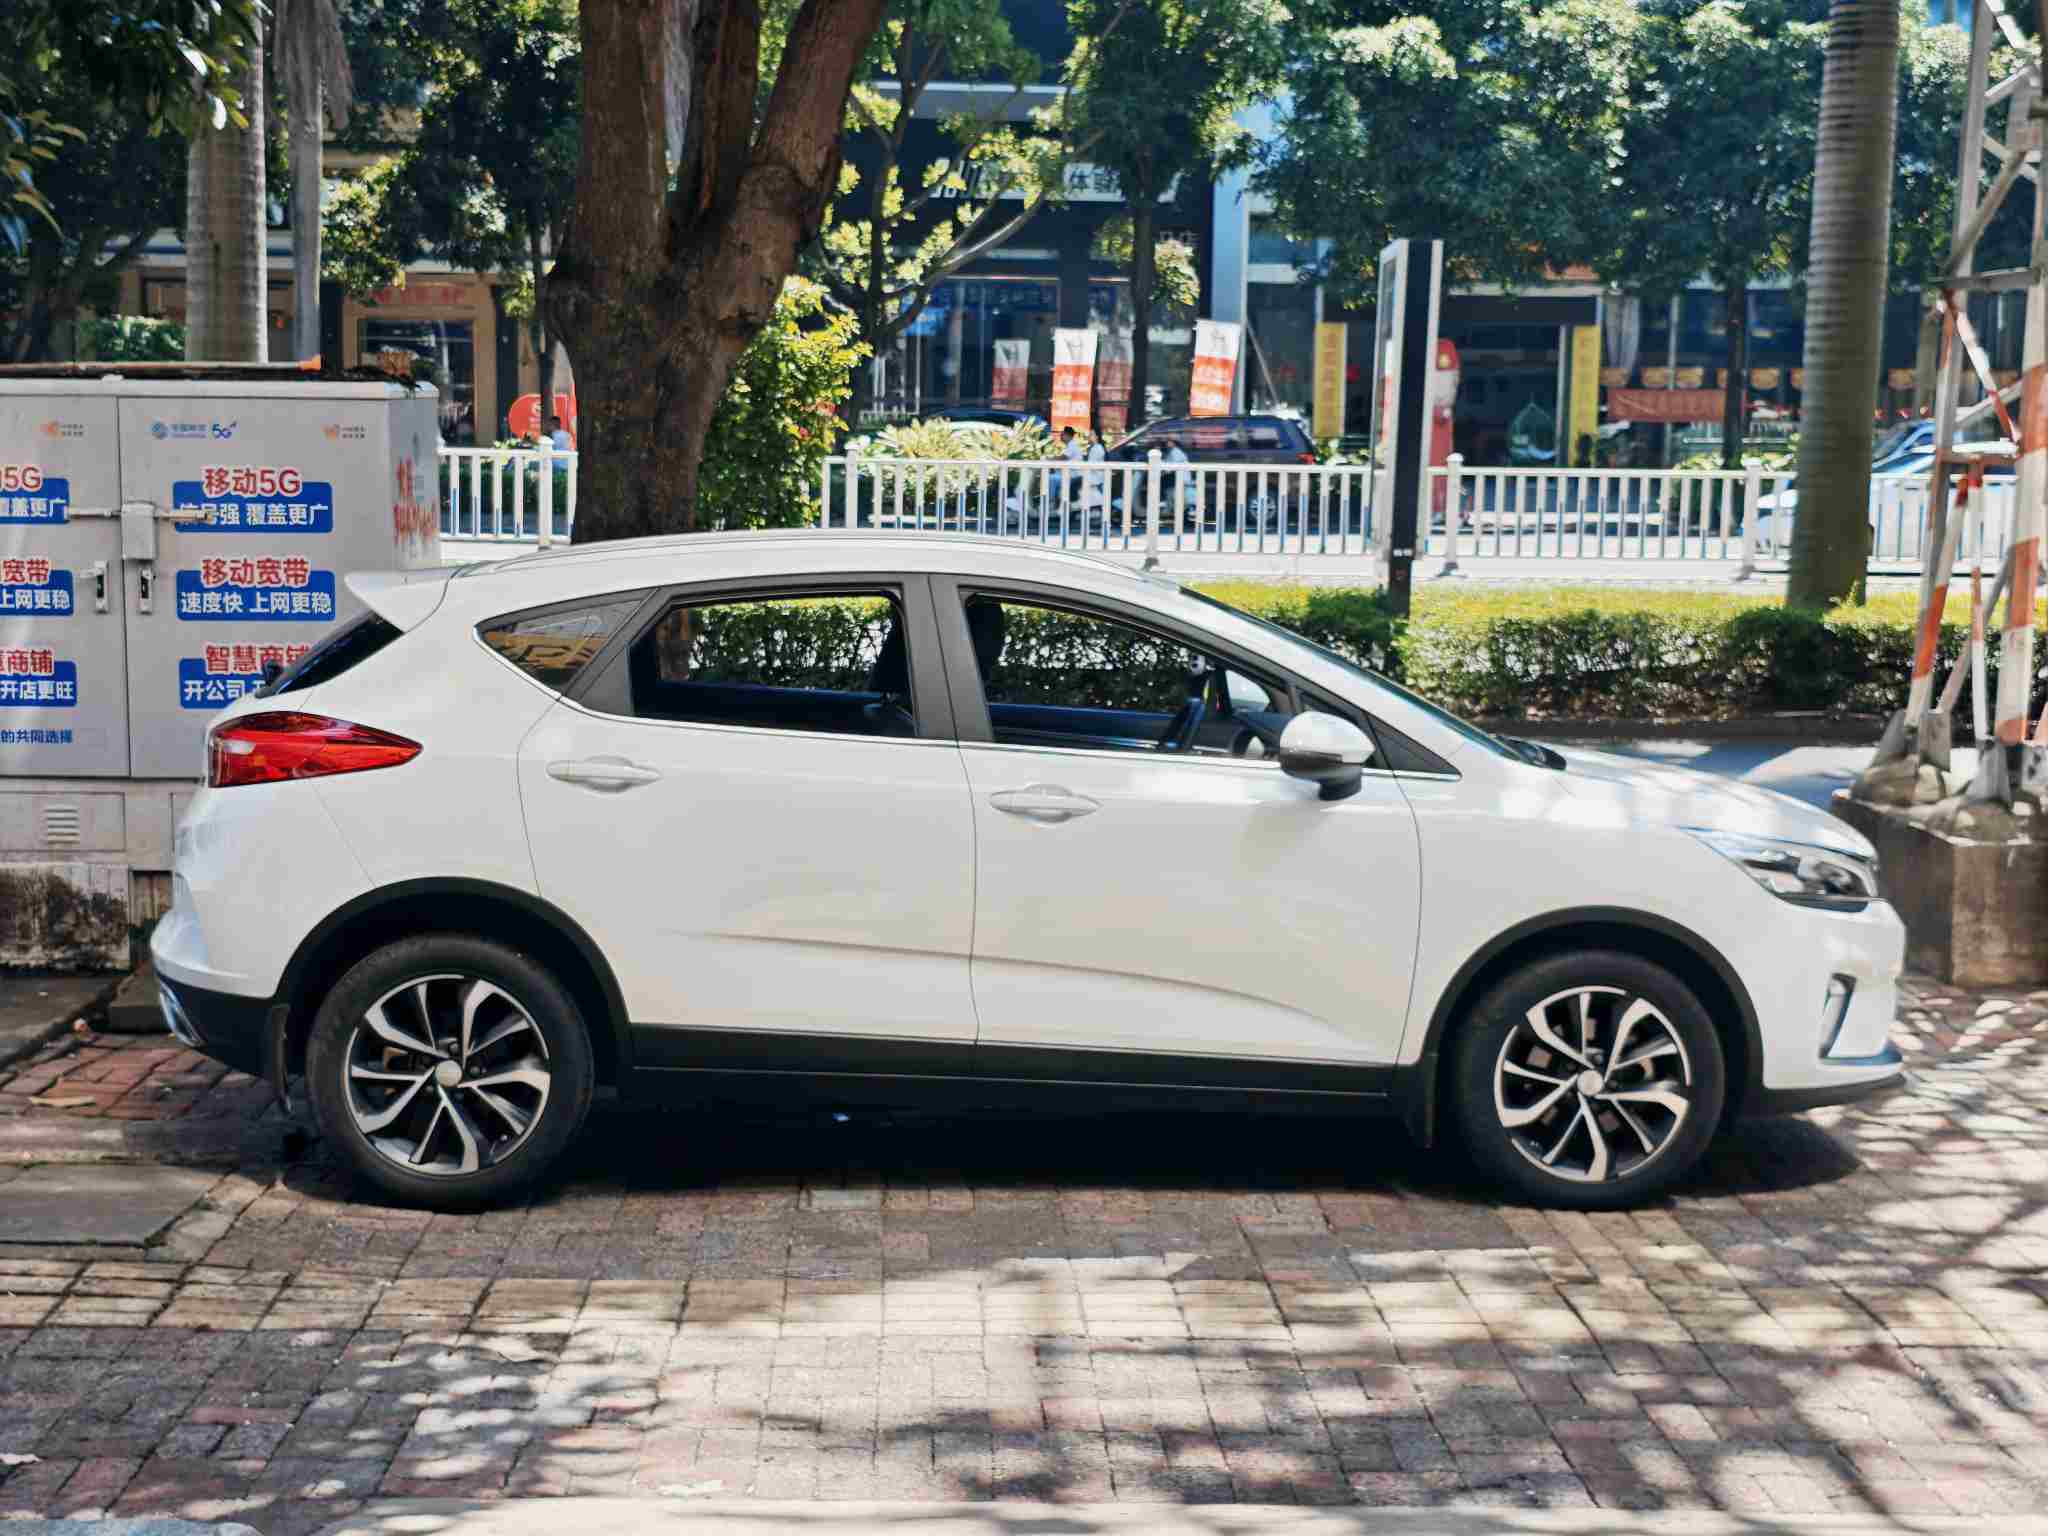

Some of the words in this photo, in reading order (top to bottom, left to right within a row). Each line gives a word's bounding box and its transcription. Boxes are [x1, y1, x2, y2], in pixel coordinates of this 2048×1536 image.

[0, 466, 42, 489] 5G
[204, 467, 301, 496] 移动5G
[246, 503, 329, 526] 覆盖更广
[202, 557, 309, 586] 移动宽带
[181, 591, 244, 614] 速度快
[250, 591, 332, 614] 上网更稳
[0, 649, 53, 673] 商铺
[184, 679, 245, 701] 开公司
